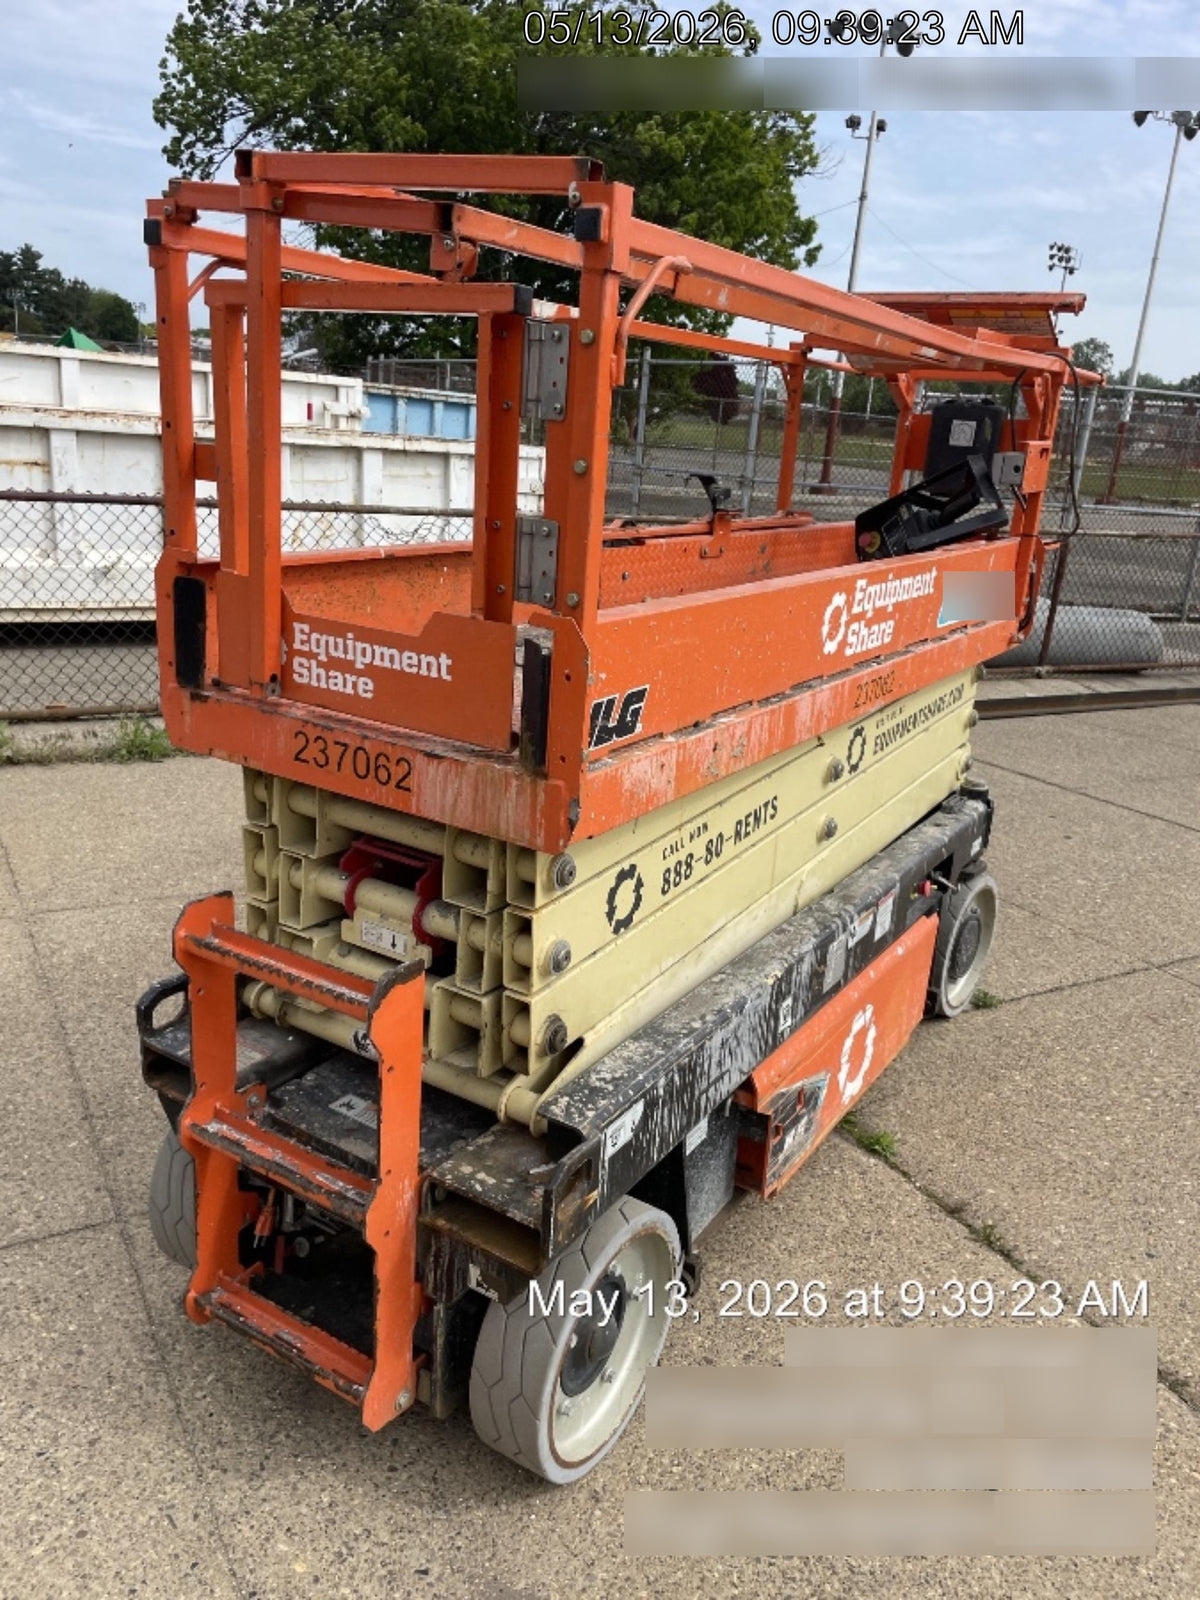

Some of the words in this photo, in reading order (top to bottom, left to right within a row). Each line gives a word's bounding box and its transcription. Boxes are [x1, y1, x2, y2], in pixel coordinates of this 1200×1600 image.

[851, 566, 938, 619] Equipment
[292, 621, 453, 682] Equipment
[844, 619, 895, 656] Share
[292, 656, 375, 700] Share
[293, 729, 413, 793] 237062
[660, 794, 778, 896] 888-80-RENTS
[662, 837, 685, 861] CALL
